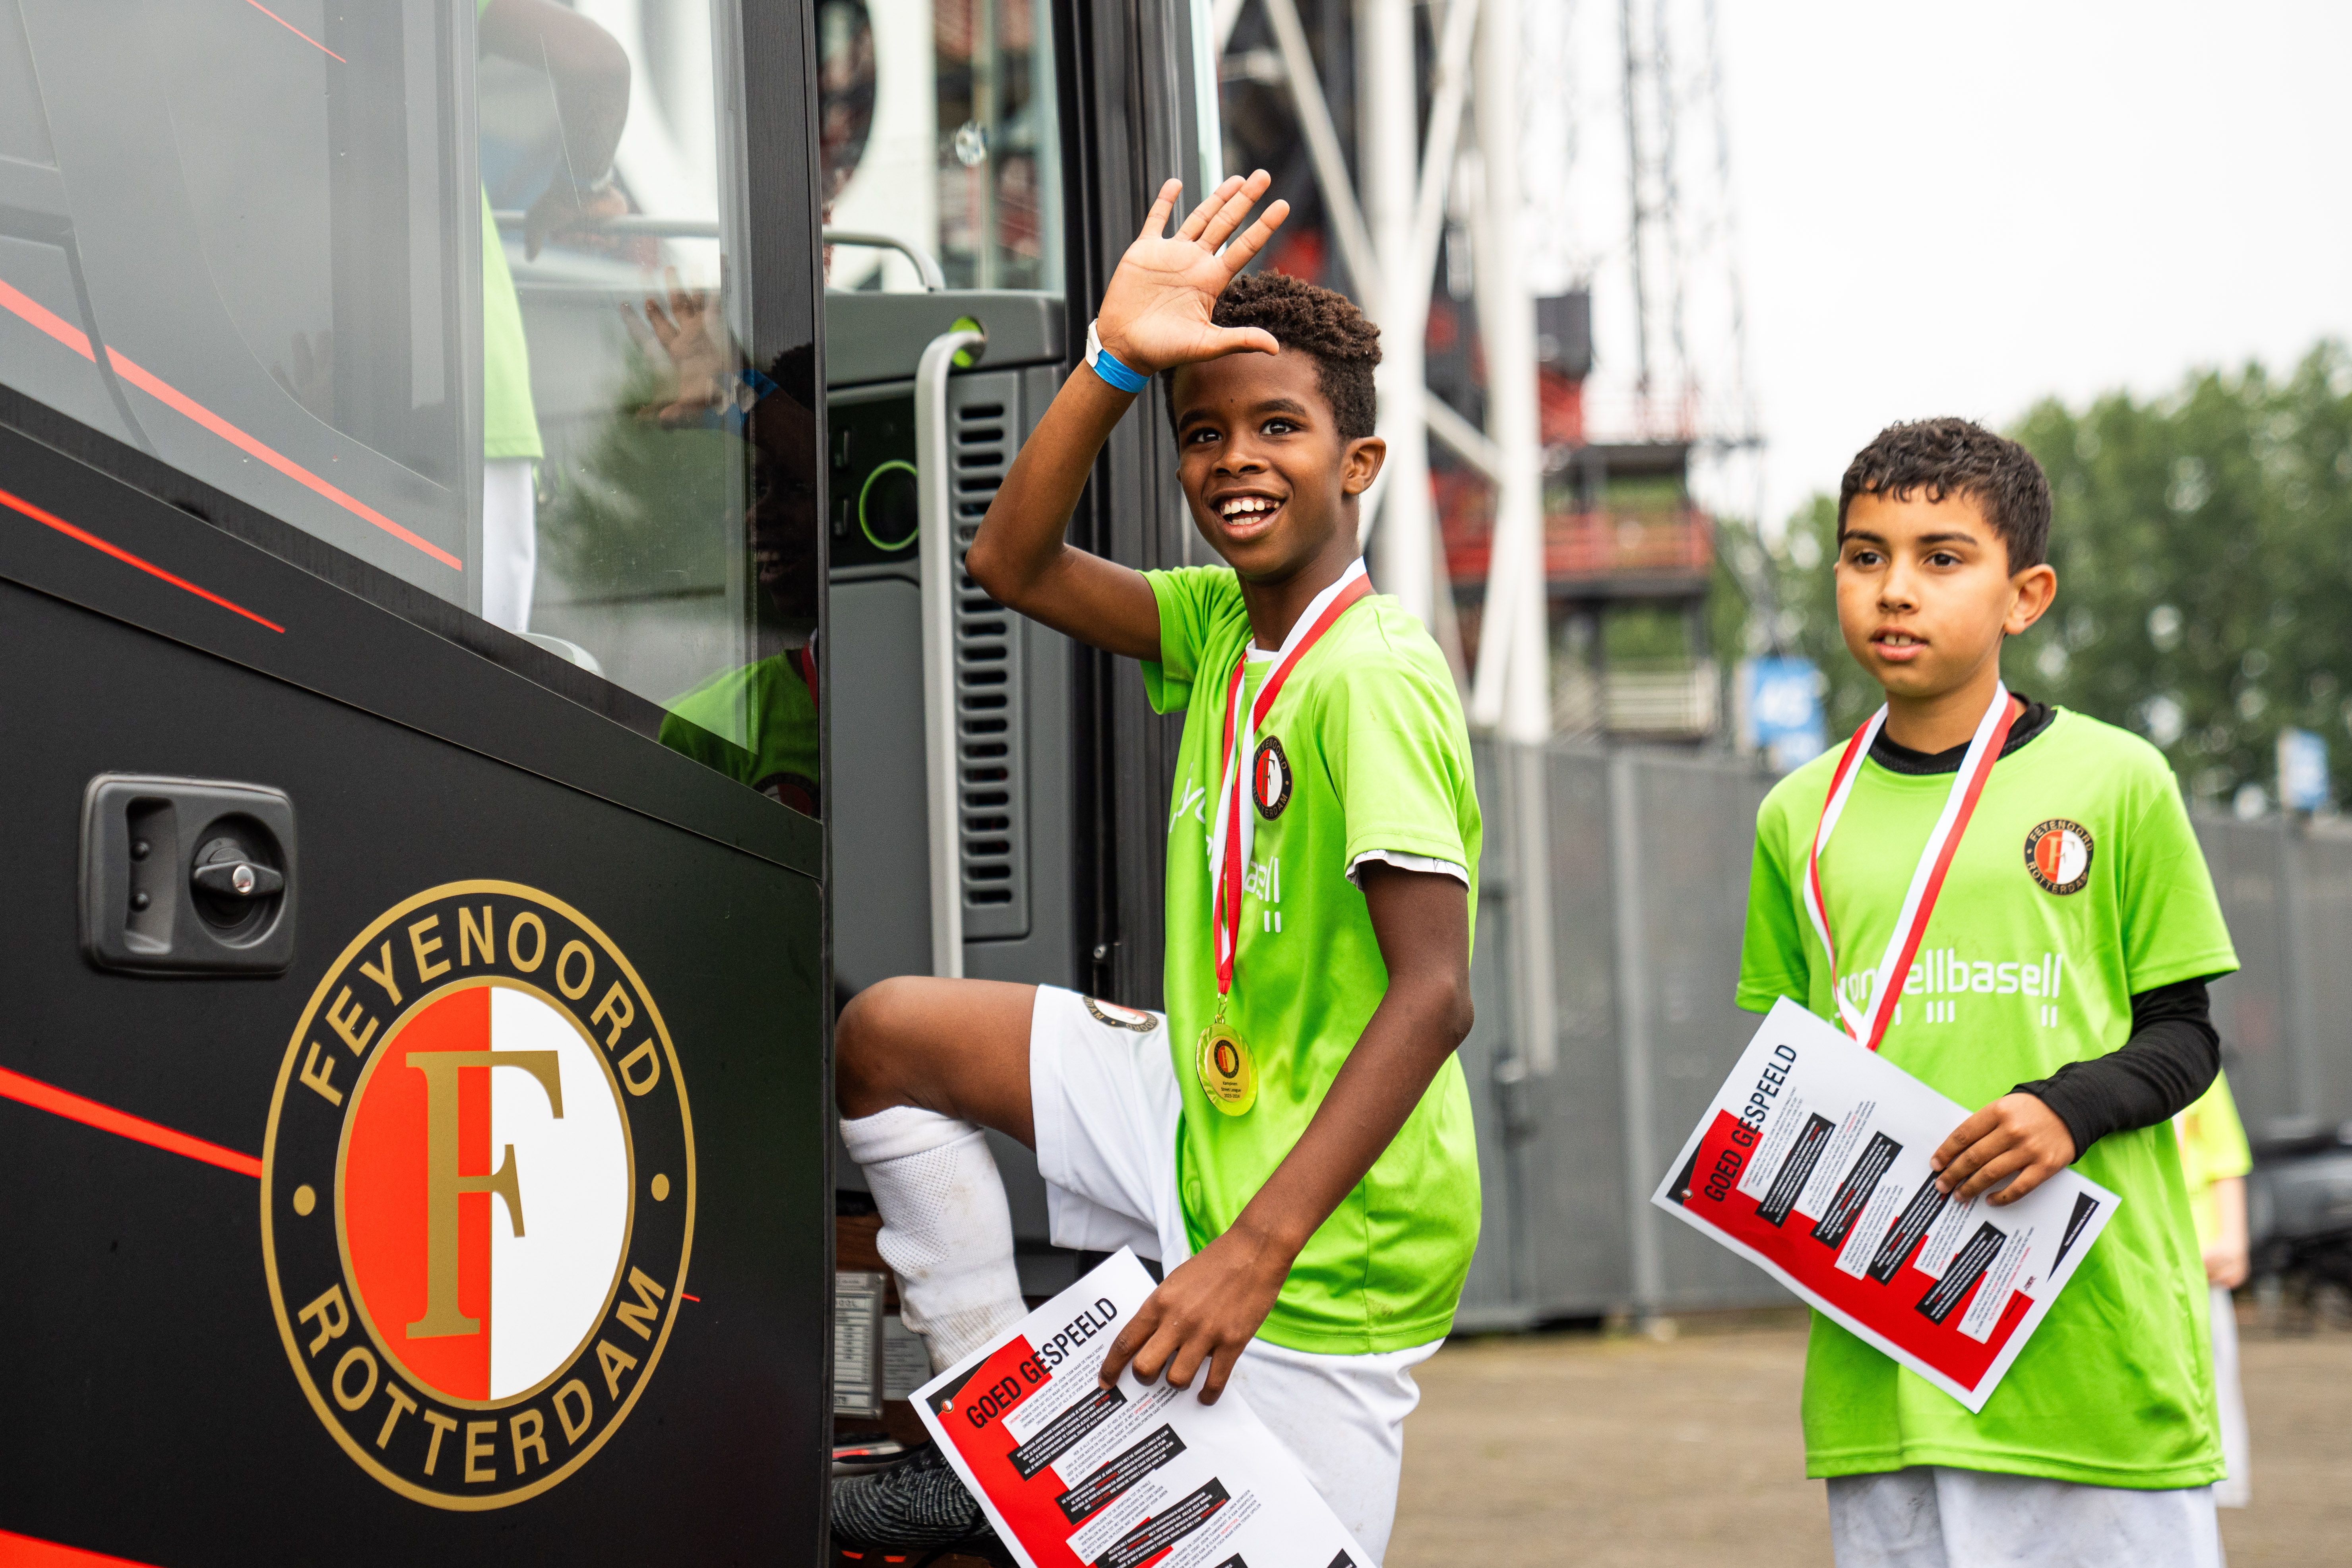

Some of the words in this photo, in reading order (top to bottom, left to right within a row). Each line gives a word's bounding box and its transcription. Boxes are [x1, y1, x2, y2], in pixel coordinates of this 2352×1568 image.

[1253, 787, 1287, 817] ROTTERDAM
[1255, 739, 1287, 769] FEYENOORD
[2029, 820, 2092, 851] FEYENOORD
[299, 906, 662, 1107] FEYENOORD
[405, 1050, 564, 1339] F
[1704, 1149, 1743, 1202] GOED
[1731, 1044, 1797, 1148] GESPEELD
[298, 1265, 666, 1484] ROTTERDAM
[966, 1376, 1022, 1429] GOED
[1019, 1297, 1118, 1384] GESPEELD
